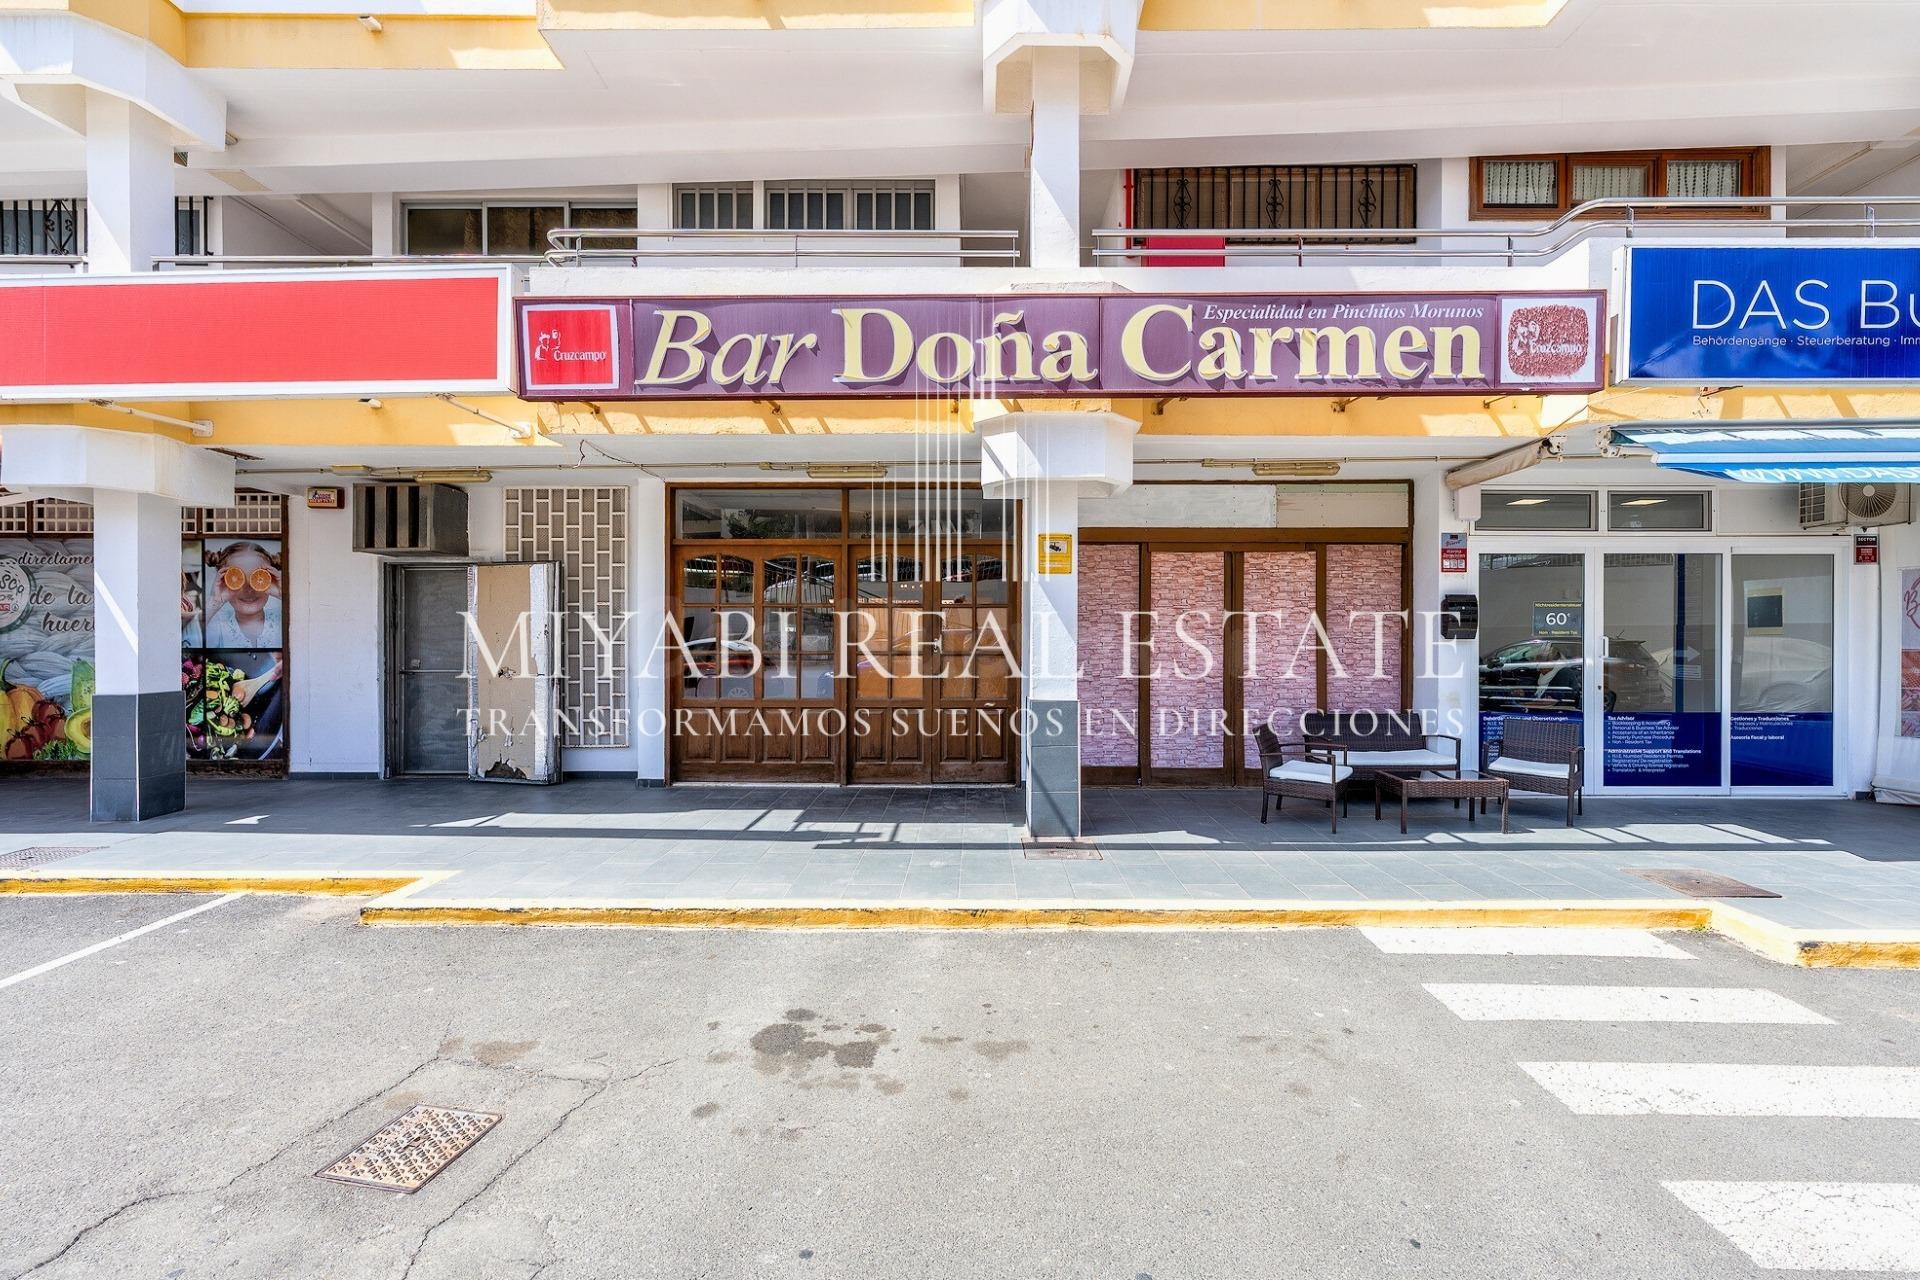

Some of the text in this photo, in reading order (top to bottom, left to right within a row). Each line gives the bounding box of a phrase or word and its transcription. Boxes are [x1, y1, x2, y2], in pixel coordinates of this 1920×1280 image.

[1203, 303, 1485, 323] Especialidad en Pinchitos Morunos
[1692, 279, 1830, 330] DAS
[635, 303, 1487, 386] Bar Doña Carmen
[1692, 334, 1787, 347] Behördengänge
[1796, 334, 1891, 347] Steuerberatung
[553, 350, 606, 362] Cruzcampo
[29, 584, 92, 605] de la
